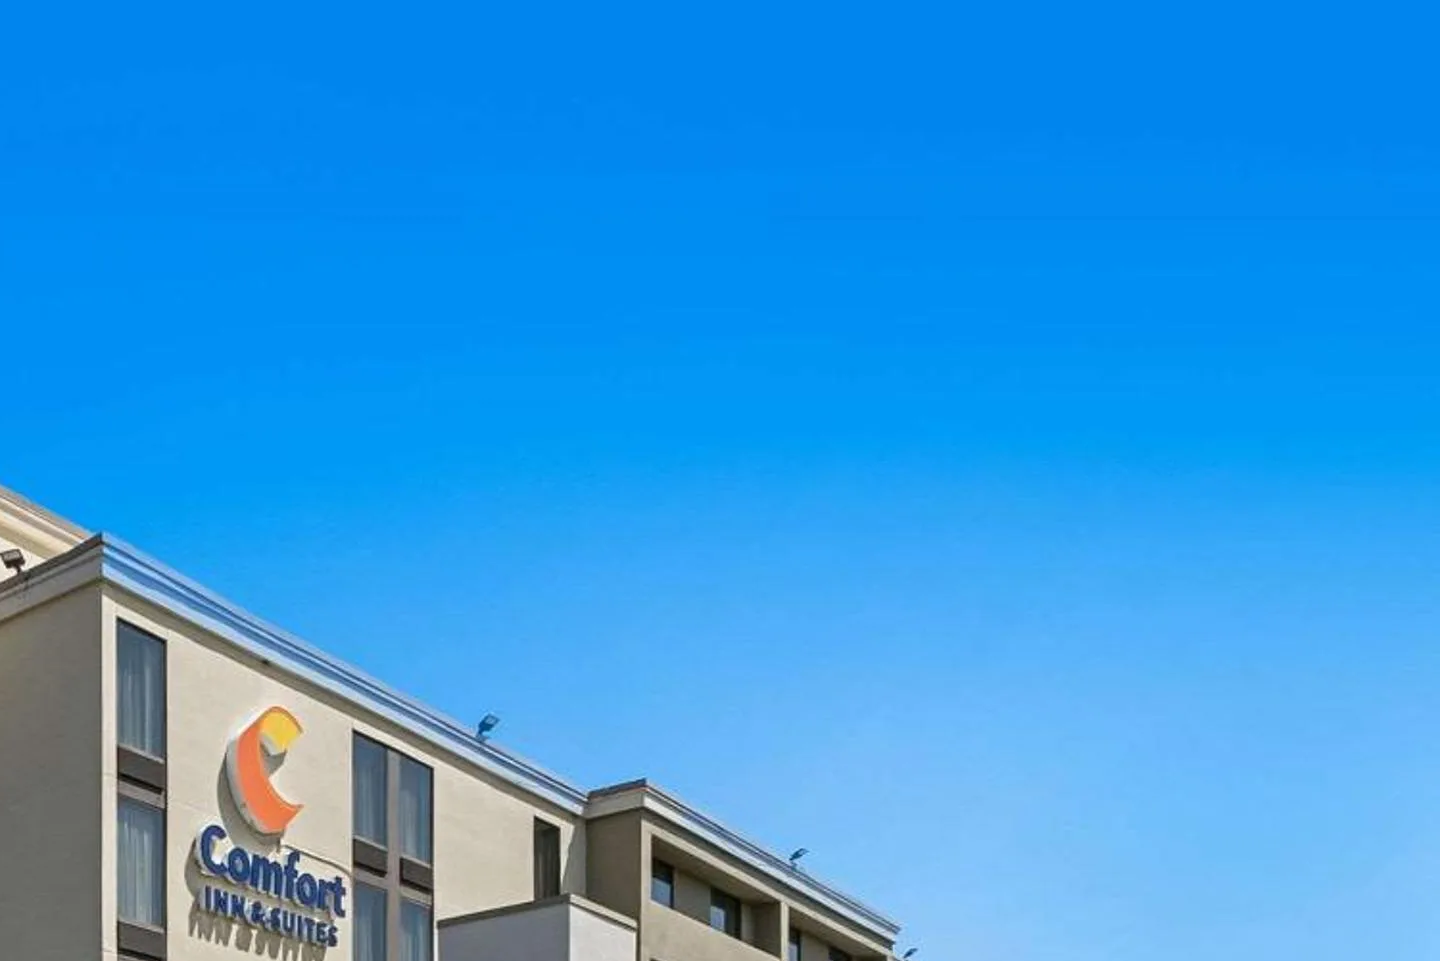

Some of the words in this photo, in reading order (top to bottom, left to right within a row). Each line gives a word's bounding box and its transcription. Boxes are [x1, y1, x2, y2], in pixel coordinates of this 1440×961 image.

[200, 824, 347, 918] Comfort
[205, 885, 246, 919] INN
[251, 900, 265, 925] &
[270, 907, 338, 948] SUITES
